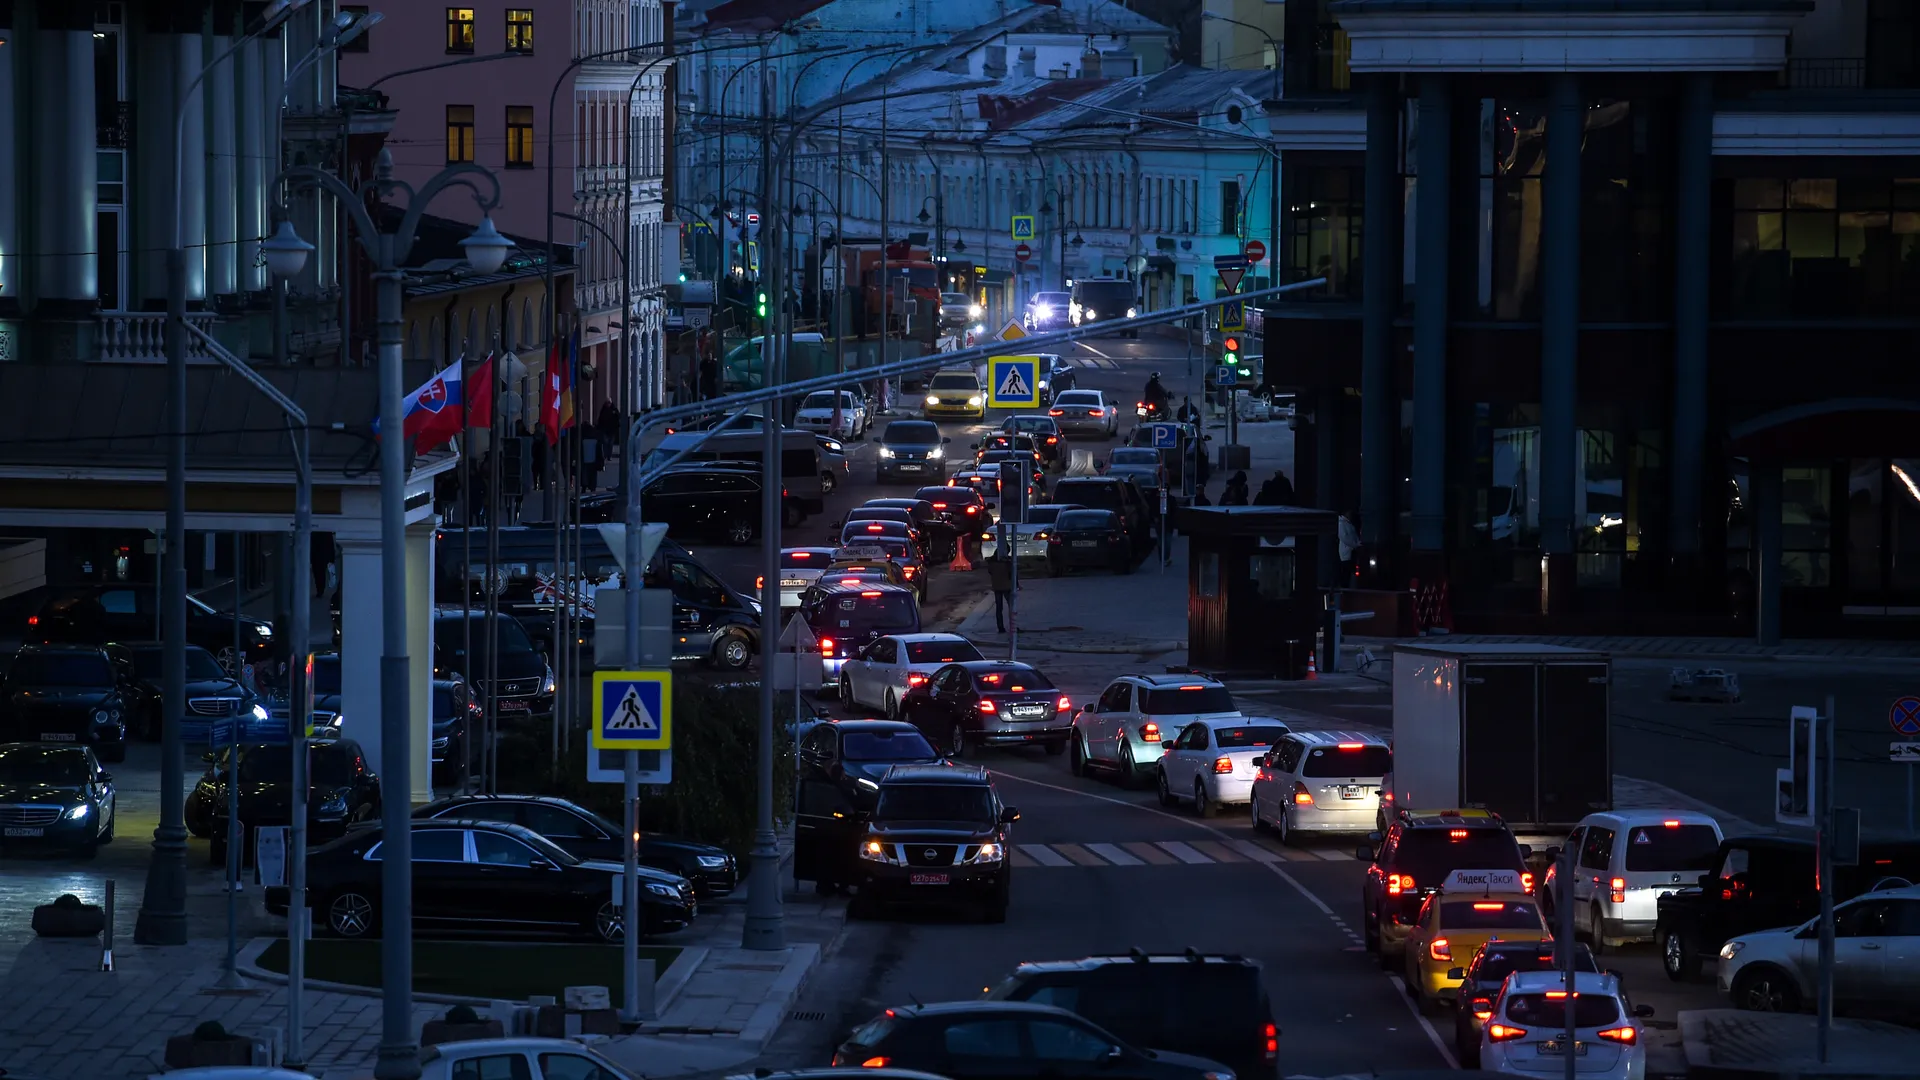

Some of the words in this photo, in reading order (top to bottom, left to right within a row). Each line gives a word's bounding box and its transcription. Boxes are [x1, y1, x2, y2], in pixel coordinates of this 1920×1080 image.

[1219, 367, 1229, 382] P
[1155, 427, 1168, 445] P
[1457, 872, 1487, 885] Яндекс
[1488, 872, 1513, 884] Такси
